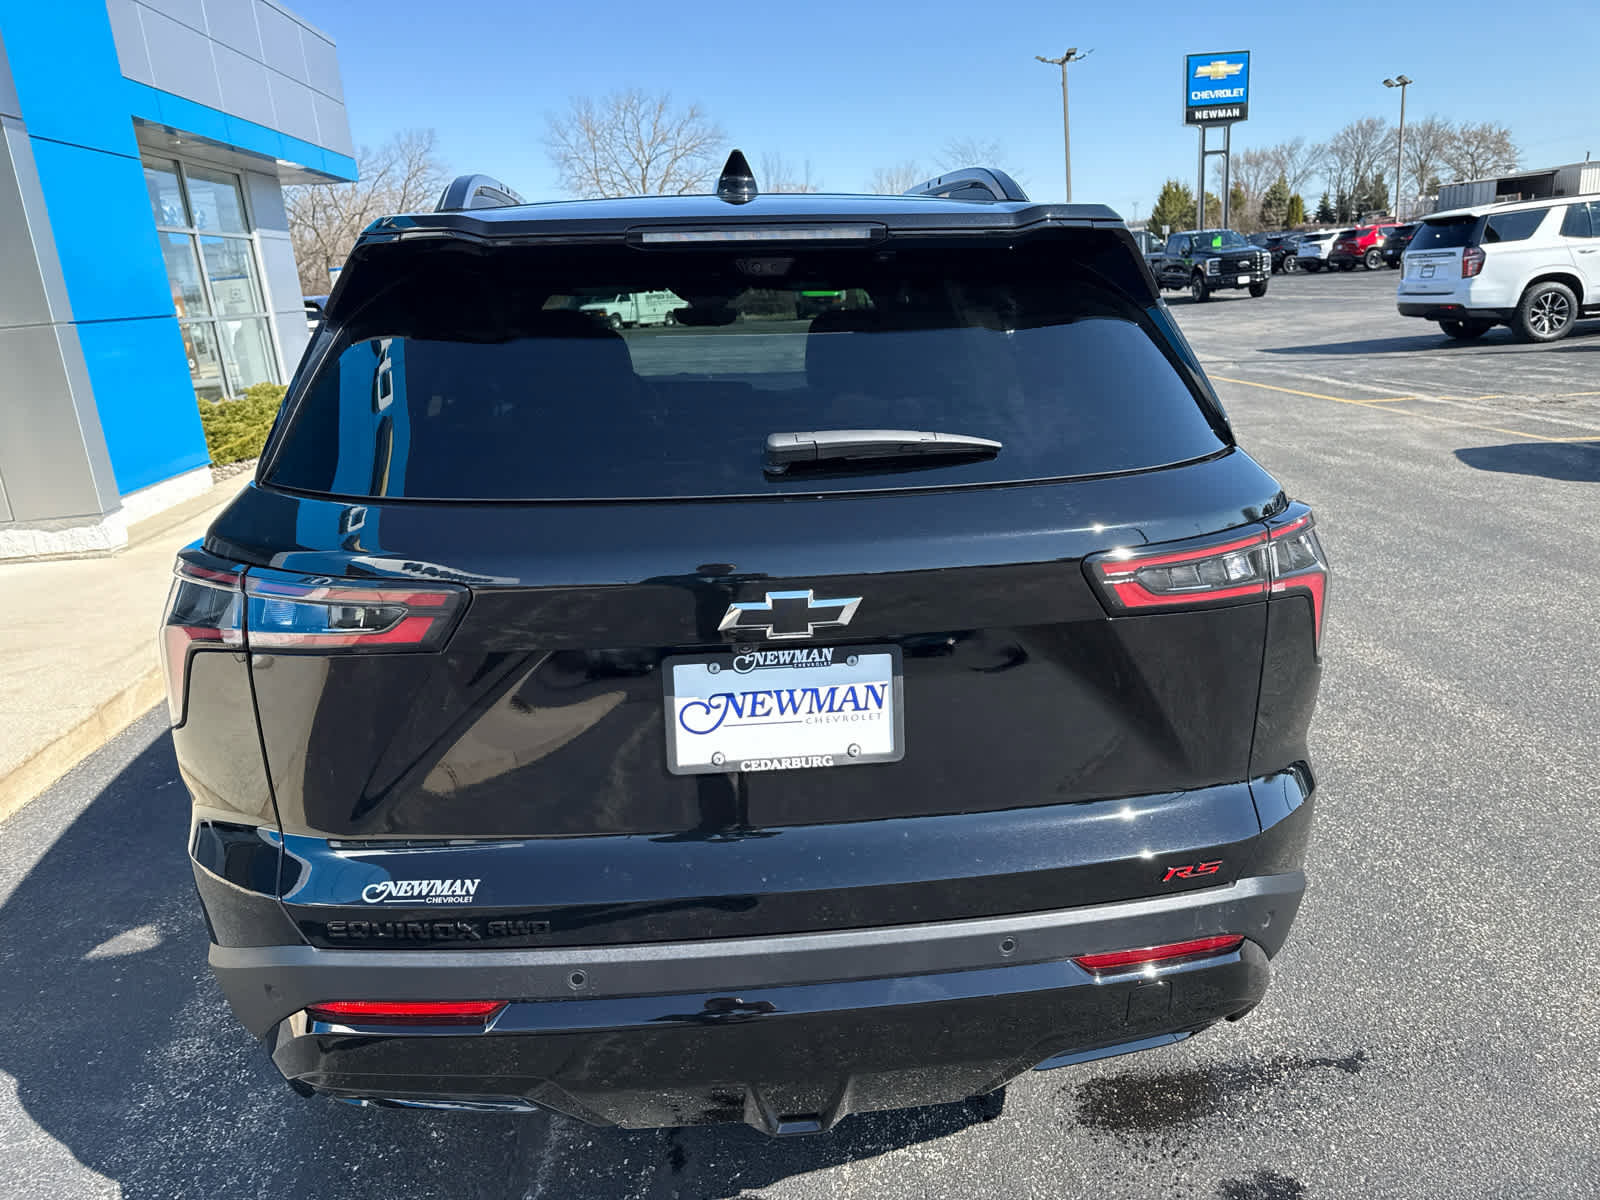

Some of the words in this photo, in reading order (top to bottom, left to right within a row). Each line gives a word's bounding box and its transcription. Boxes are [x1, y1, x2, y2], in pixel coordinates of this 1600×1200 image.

[1191, 87, 1245, 101] CHEVROLET
[1195, 107, 1240, 120] NEWMAN
[733, 647, 834, 674] NEWMAN
[679, 683, 888, 735] NEWMAN
[805, 712, 882, 725] CHEVROLET
[740, 755, 834, 772] CEDARBURG
[1162, 860, 1223, 882] RS
[361, 878, 480, 904] NEWMAN
[425, 895, 474, 904] CHEVROLET
[326, 919, 481, 940] EQUINOX
